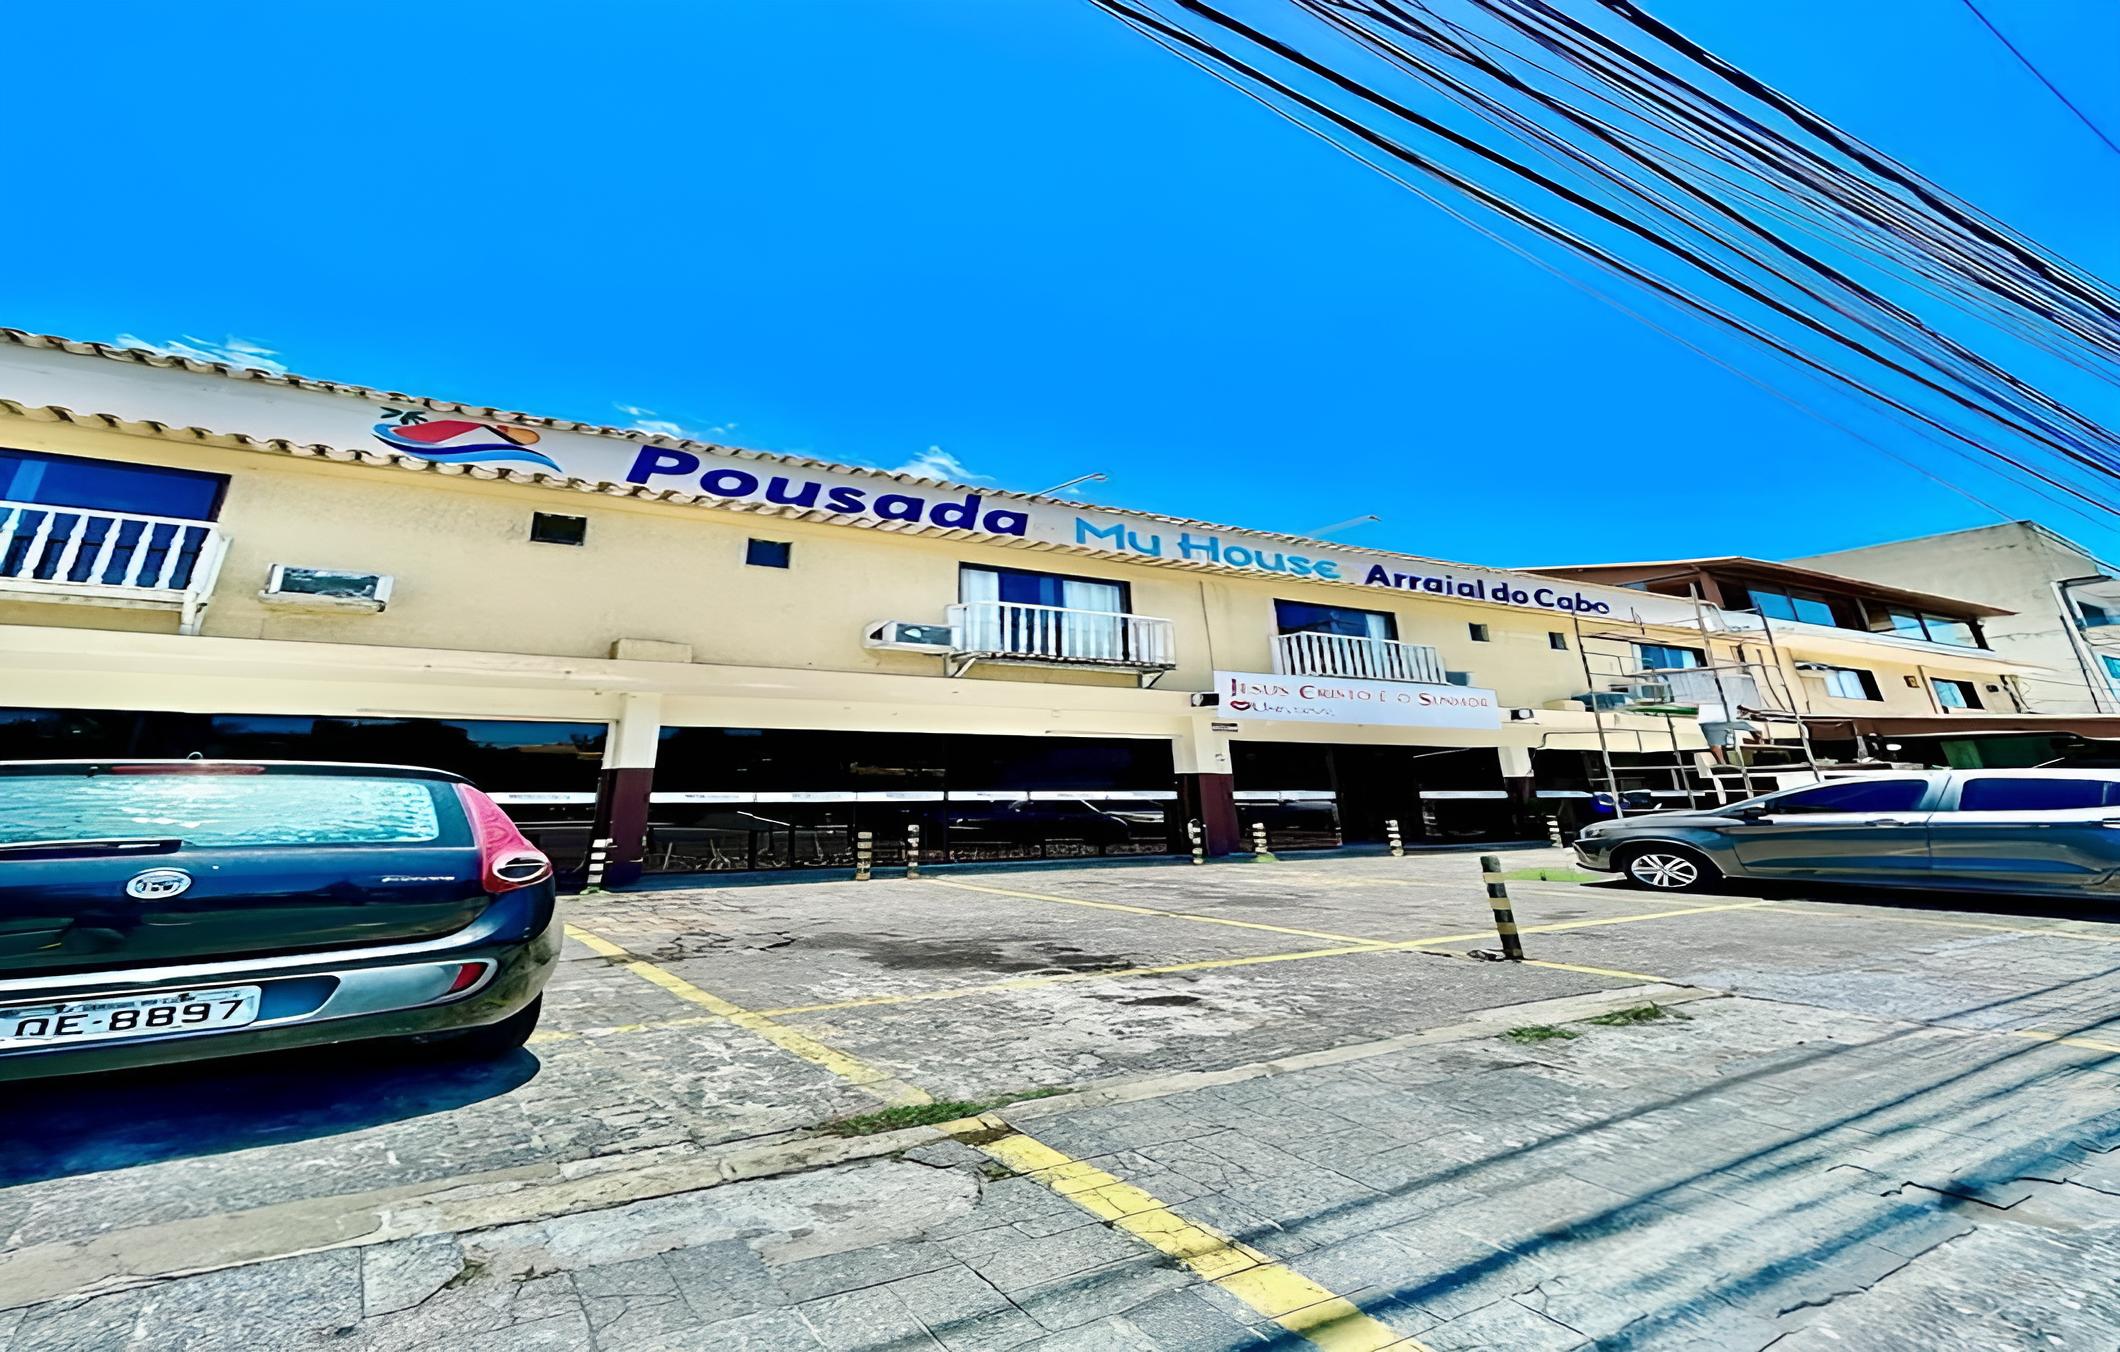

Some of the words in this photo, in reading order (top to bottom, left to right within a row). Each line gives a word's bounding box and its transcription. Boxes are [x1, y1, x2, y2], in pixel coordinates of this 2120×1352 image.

[625, 444, 1029, 537] Pousada
[1177, 532, 1342, 580] House
[1365, 563, 1486, 600] Arraial
[1491, 582, 1529, 605] do
[1534, 588, 1610, 615] Cabo
